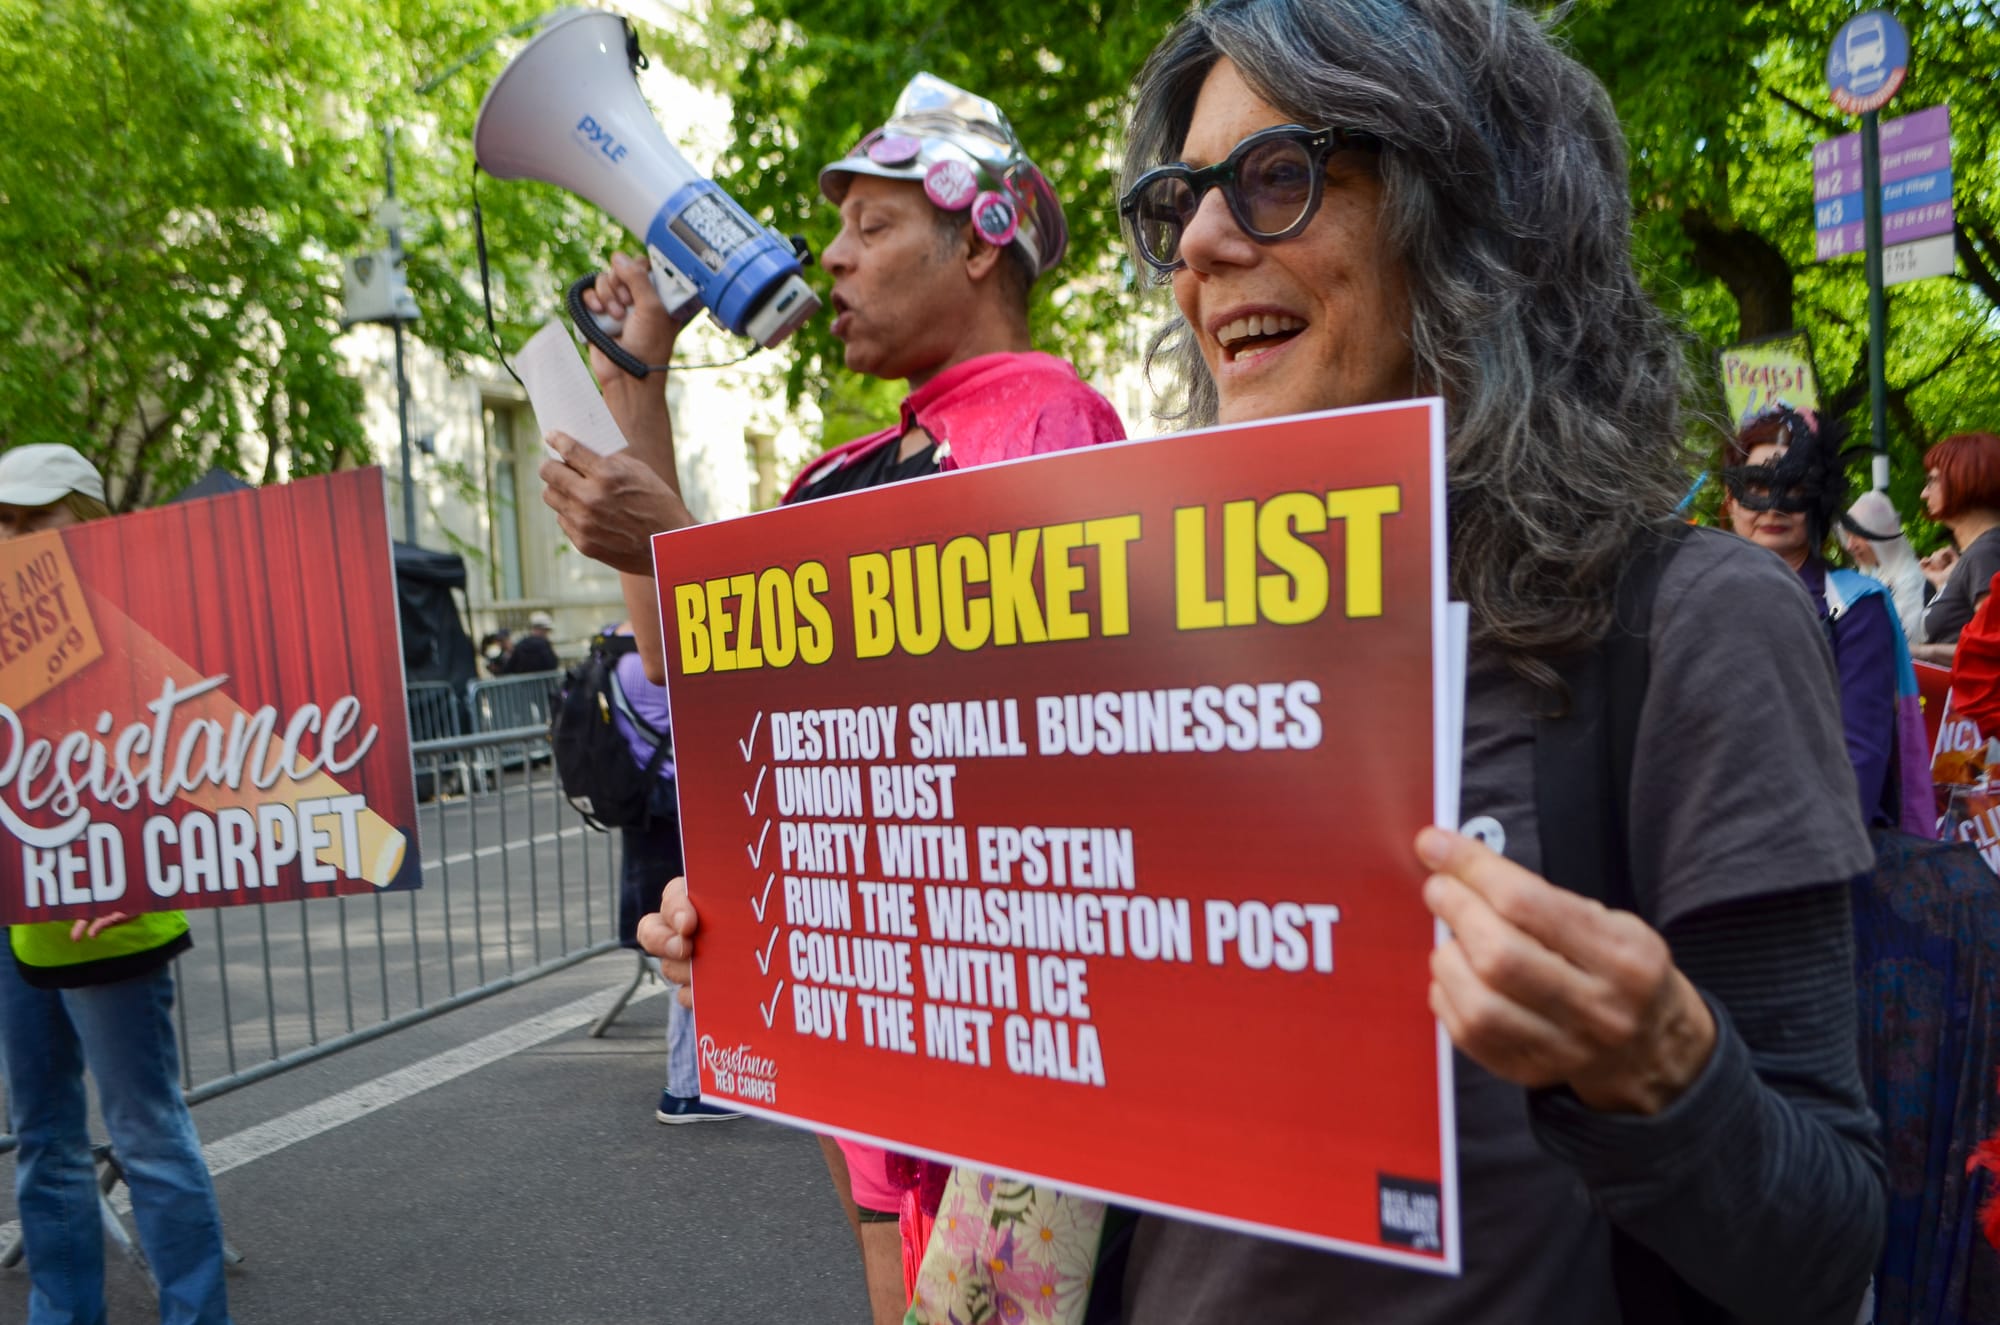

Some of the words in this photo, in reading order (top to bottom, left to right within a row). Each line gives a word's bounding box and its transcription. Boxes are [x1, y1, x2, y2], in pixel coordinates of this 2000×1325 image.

[577, 114, 628, 164] PYLE
[1815, 140, 1840, 170] M1
[1816, 169, 1842, 200] M2
[1817, 198, 1843, 229] M3
[1818, 227, 1844, 259] M4
[16, 550, 59, 602] AND
[674, 561, 834, 674] BEZOS
[849, 514, 1141, 659] BUCKET
[1174, 485, 1400, 630] LIST
[770, 705, 898, 761] DESTROY
[908, 698, 1027, 759] SMALL
[1036, 680, 1322, 755] BUSINESSES
[774, 765, 863, 818] UNION
[869, 764, 956, 820] BUST
[23, 822, 127, 908] RED
[143, 794, 367, 897] CARPET
[779, 821, 867, 875] PARTY
[876, 824, 969, 881] WITH
[977, 826, 1135, 890] EPSTEIN
[783, 875, 852, 931] RUIN
[857, 881, 918, 937] THE
[924, 885, 1192, 962] WASHINGTON
[1205, 900, 1339, 973] POST
[788, 930, 914, 995] COLLUDE
[920, 944, 1018, 1010] WITH
[1027, 955, 1090, 1019] ICE
[700, 1033, 779, 1080] Resistance
[792, 984, 848, 1041] BUY
[856, 993, 917, 1054] THE
[923, 1003, 993, 1067] MET
[1004, 1014, 1106, 1087] GALA
[715, 1071, 735, 1095] RED
[737, 1075, 777, 1105] CARPET
